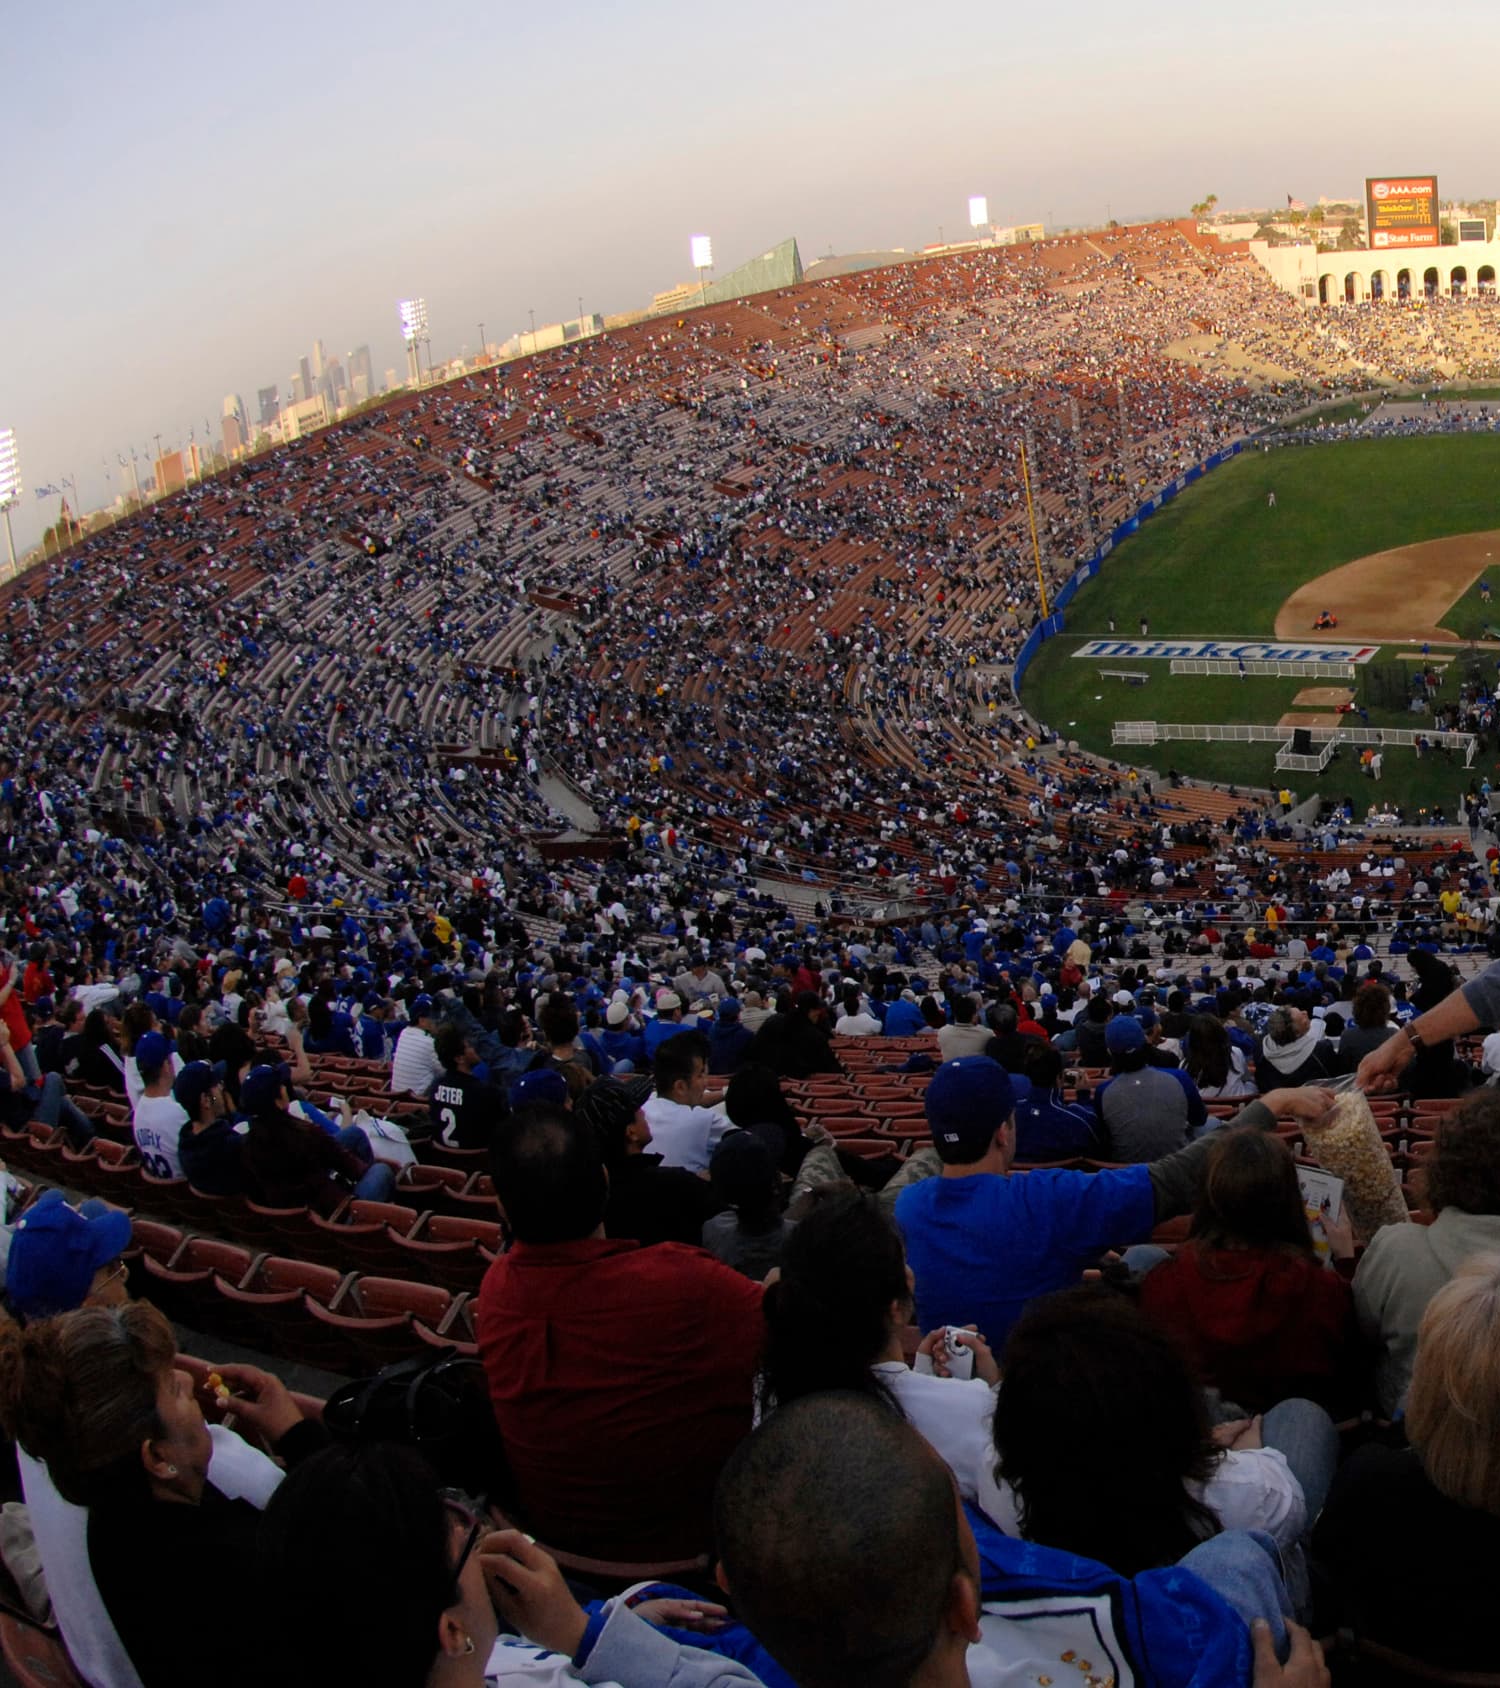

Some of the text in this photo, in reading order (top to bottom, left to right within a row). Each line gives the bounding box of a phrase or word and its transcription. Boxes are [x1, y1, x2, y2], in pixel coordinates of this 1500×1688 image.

[1389, 184, 1432, 195] AAA.com
[1389, 231, 1434, 243] State Farm
[1085, 641, 1375, 662] ThinkCure!
[434, 1084, 464, 1106] JETER
[440, 1107, 459, 1148] 2
